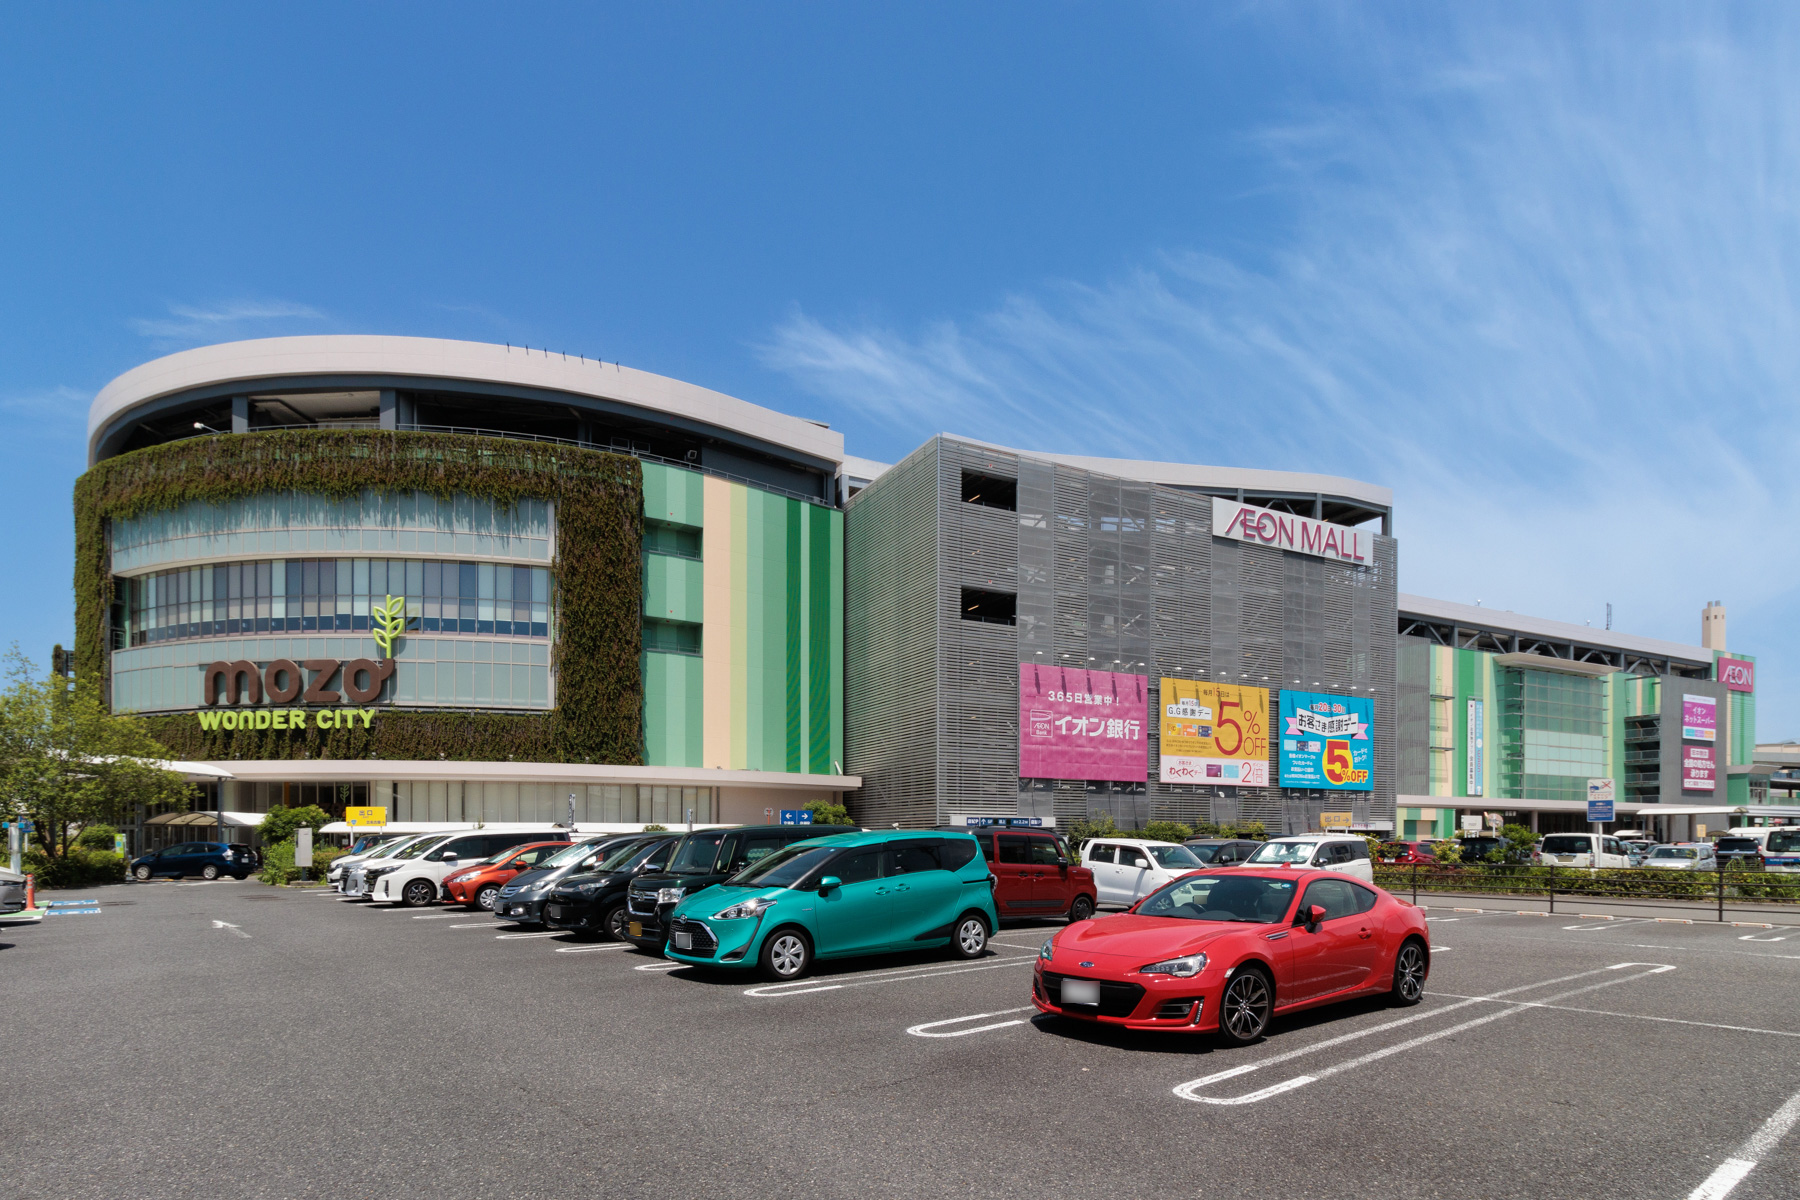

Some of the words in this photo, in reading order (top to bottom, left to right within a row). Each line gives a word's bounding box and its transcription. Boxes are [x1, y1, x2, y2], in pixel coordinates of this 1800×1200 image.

[1301, 521, 1364, 561] MALL
[204, 658, 396, 706] mozo
[197, 709, 306, 732] WONDER
[317, 709, 376, 730] CITY
[1168, 706, 1211, 717] G.G感謝デー
[1684, 715, 1715, 724] ネットスーパー
[1692, 706, 1707, 715] イオン
[1055, 716, 1140, 740] イオン銀行
[1298, 714, 1357, 734] お客さま感謝デー
[1243, 737, 1267, 757] OFF
[1325, 815, 1341, 823] 出口
